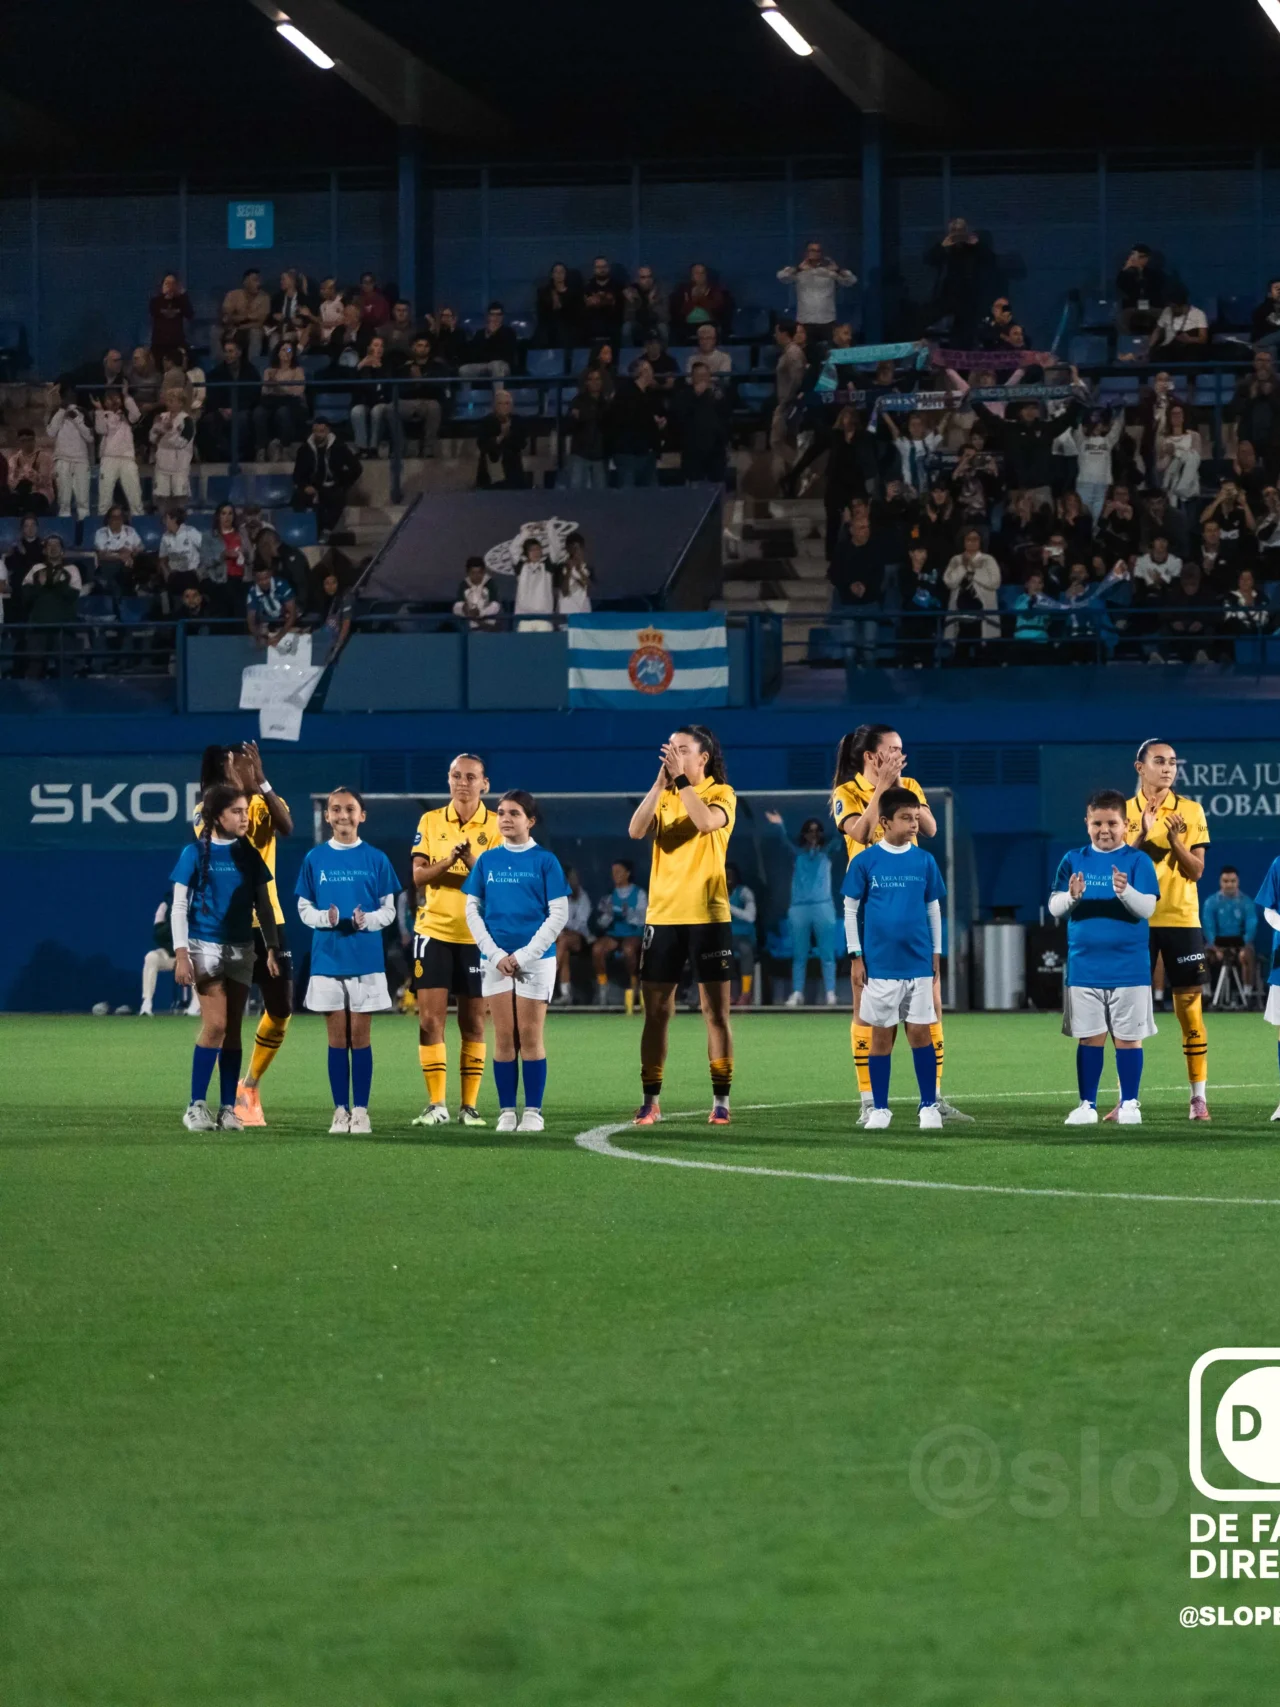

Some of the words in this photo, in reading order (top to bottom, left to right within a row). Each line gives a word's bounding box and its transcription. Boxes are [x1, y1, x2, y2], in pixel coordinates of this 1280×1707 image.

[245, 220, 257, 239] B
[414, 934, 431, 959] 17
[701, 949, 733, 960] SKODA
[1176, 952, 1206, 964] SKODA
